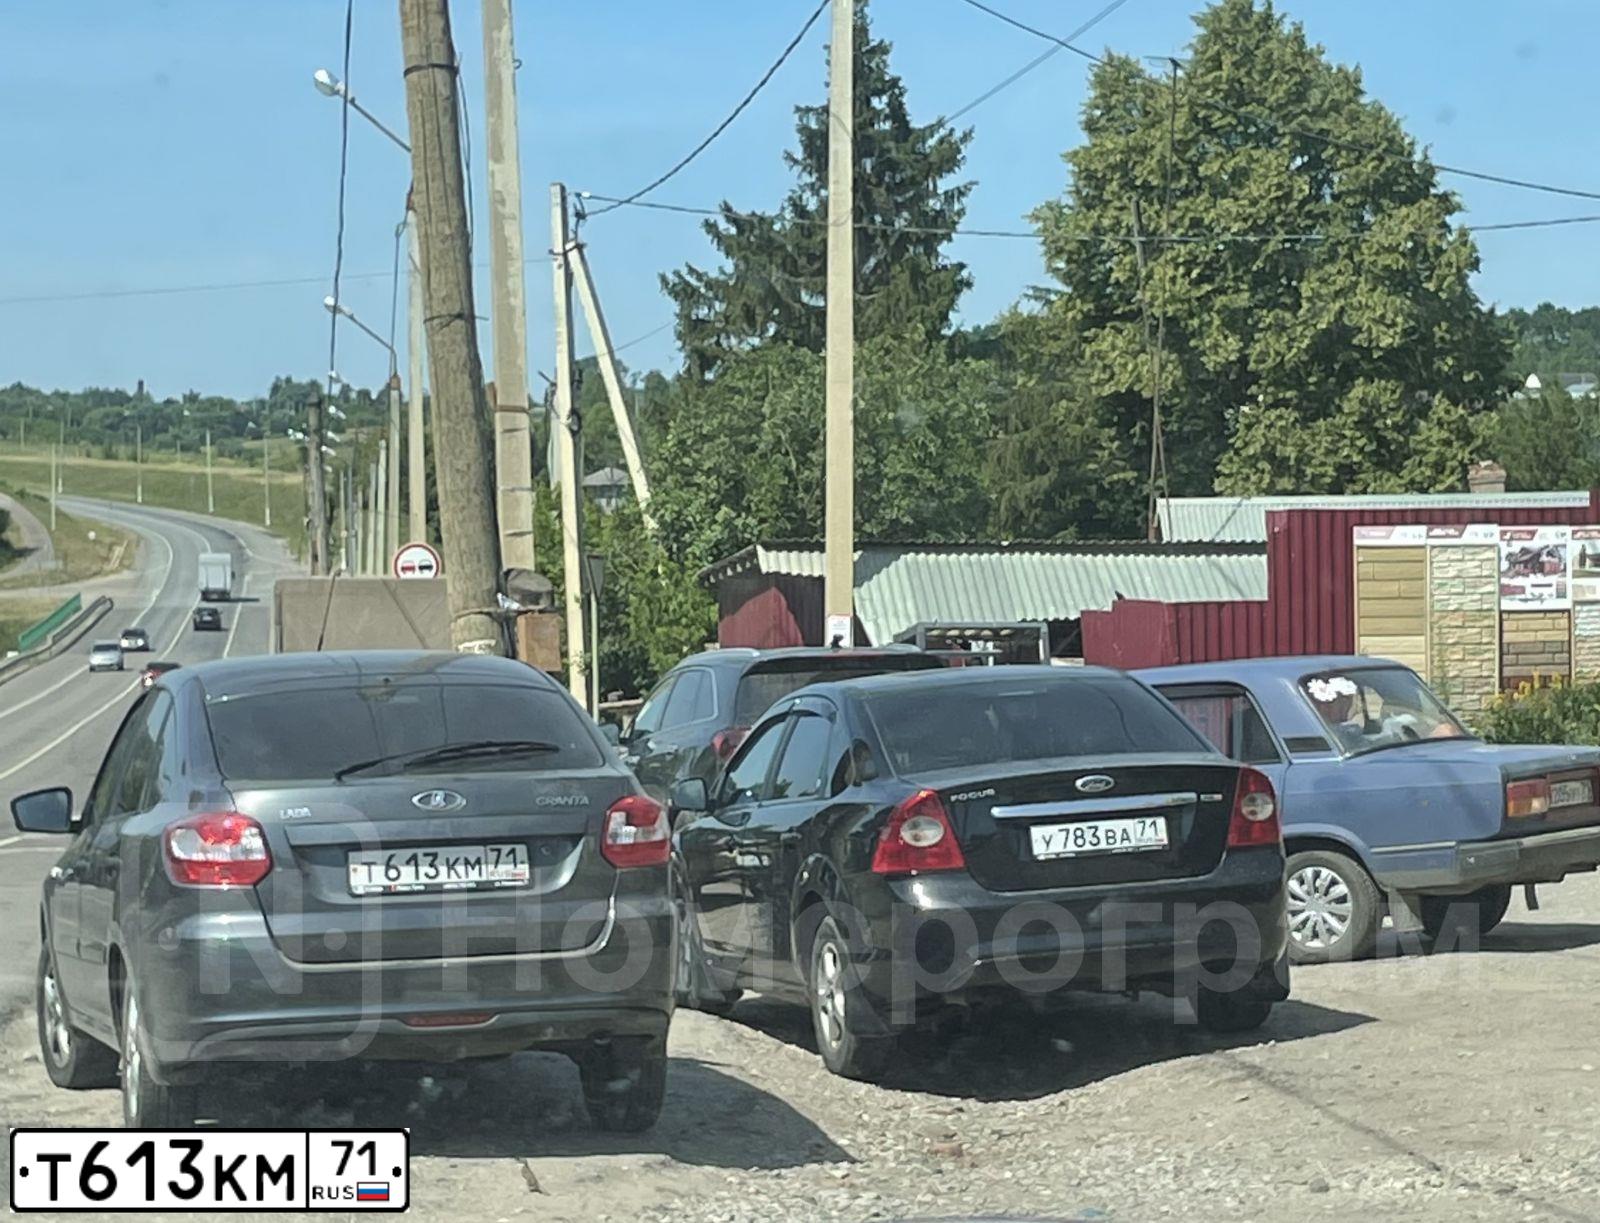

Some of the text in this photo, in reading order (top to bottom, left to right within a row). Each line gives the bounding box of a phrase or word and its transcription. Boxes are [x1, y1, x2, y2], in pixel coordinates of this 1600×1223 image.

[535, 794, 590, 807] GRANTA
[950, 788, 996, 802] FOCUS
[279, 807, 312, 819] LADA
[1136, 819, 1160, 838] 71
[489, 847, 518, 869] 71
